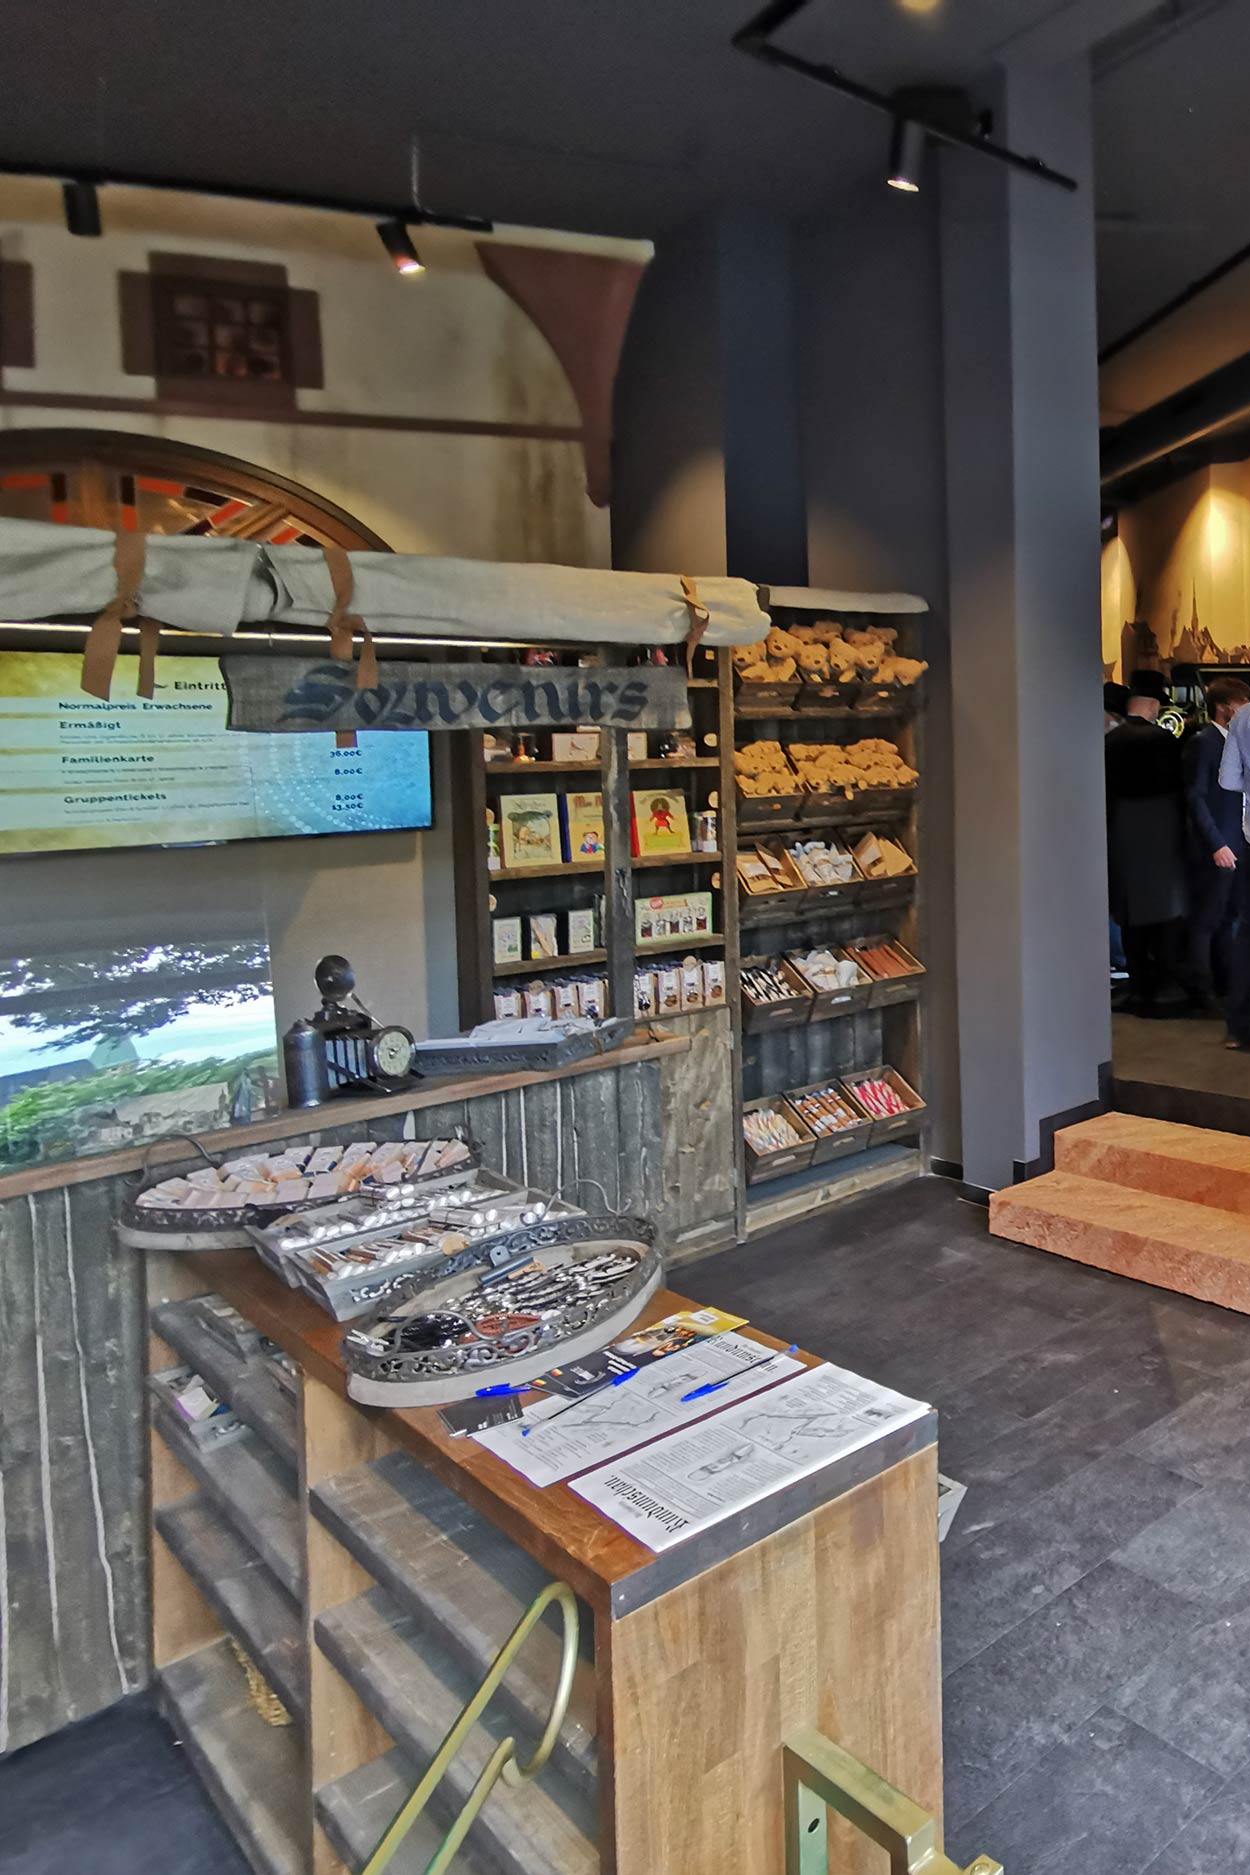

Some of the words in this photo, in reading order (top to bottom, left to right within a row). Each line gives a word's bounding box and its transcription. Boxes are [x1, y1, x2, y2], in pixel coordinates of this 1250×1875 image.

[174, 681, 227, 690] Eintritt
[276, 664, 649, 724] Souvenirs
[58, 702, 137, 711] Normalpreis
[142, 702, 213, 711] Erwachsene
[59, 721, 121, 730] Ermäßigt
[61, 755, 155, 764] Familienkarte
[64, 793, 167, 804] Gruppentickets
